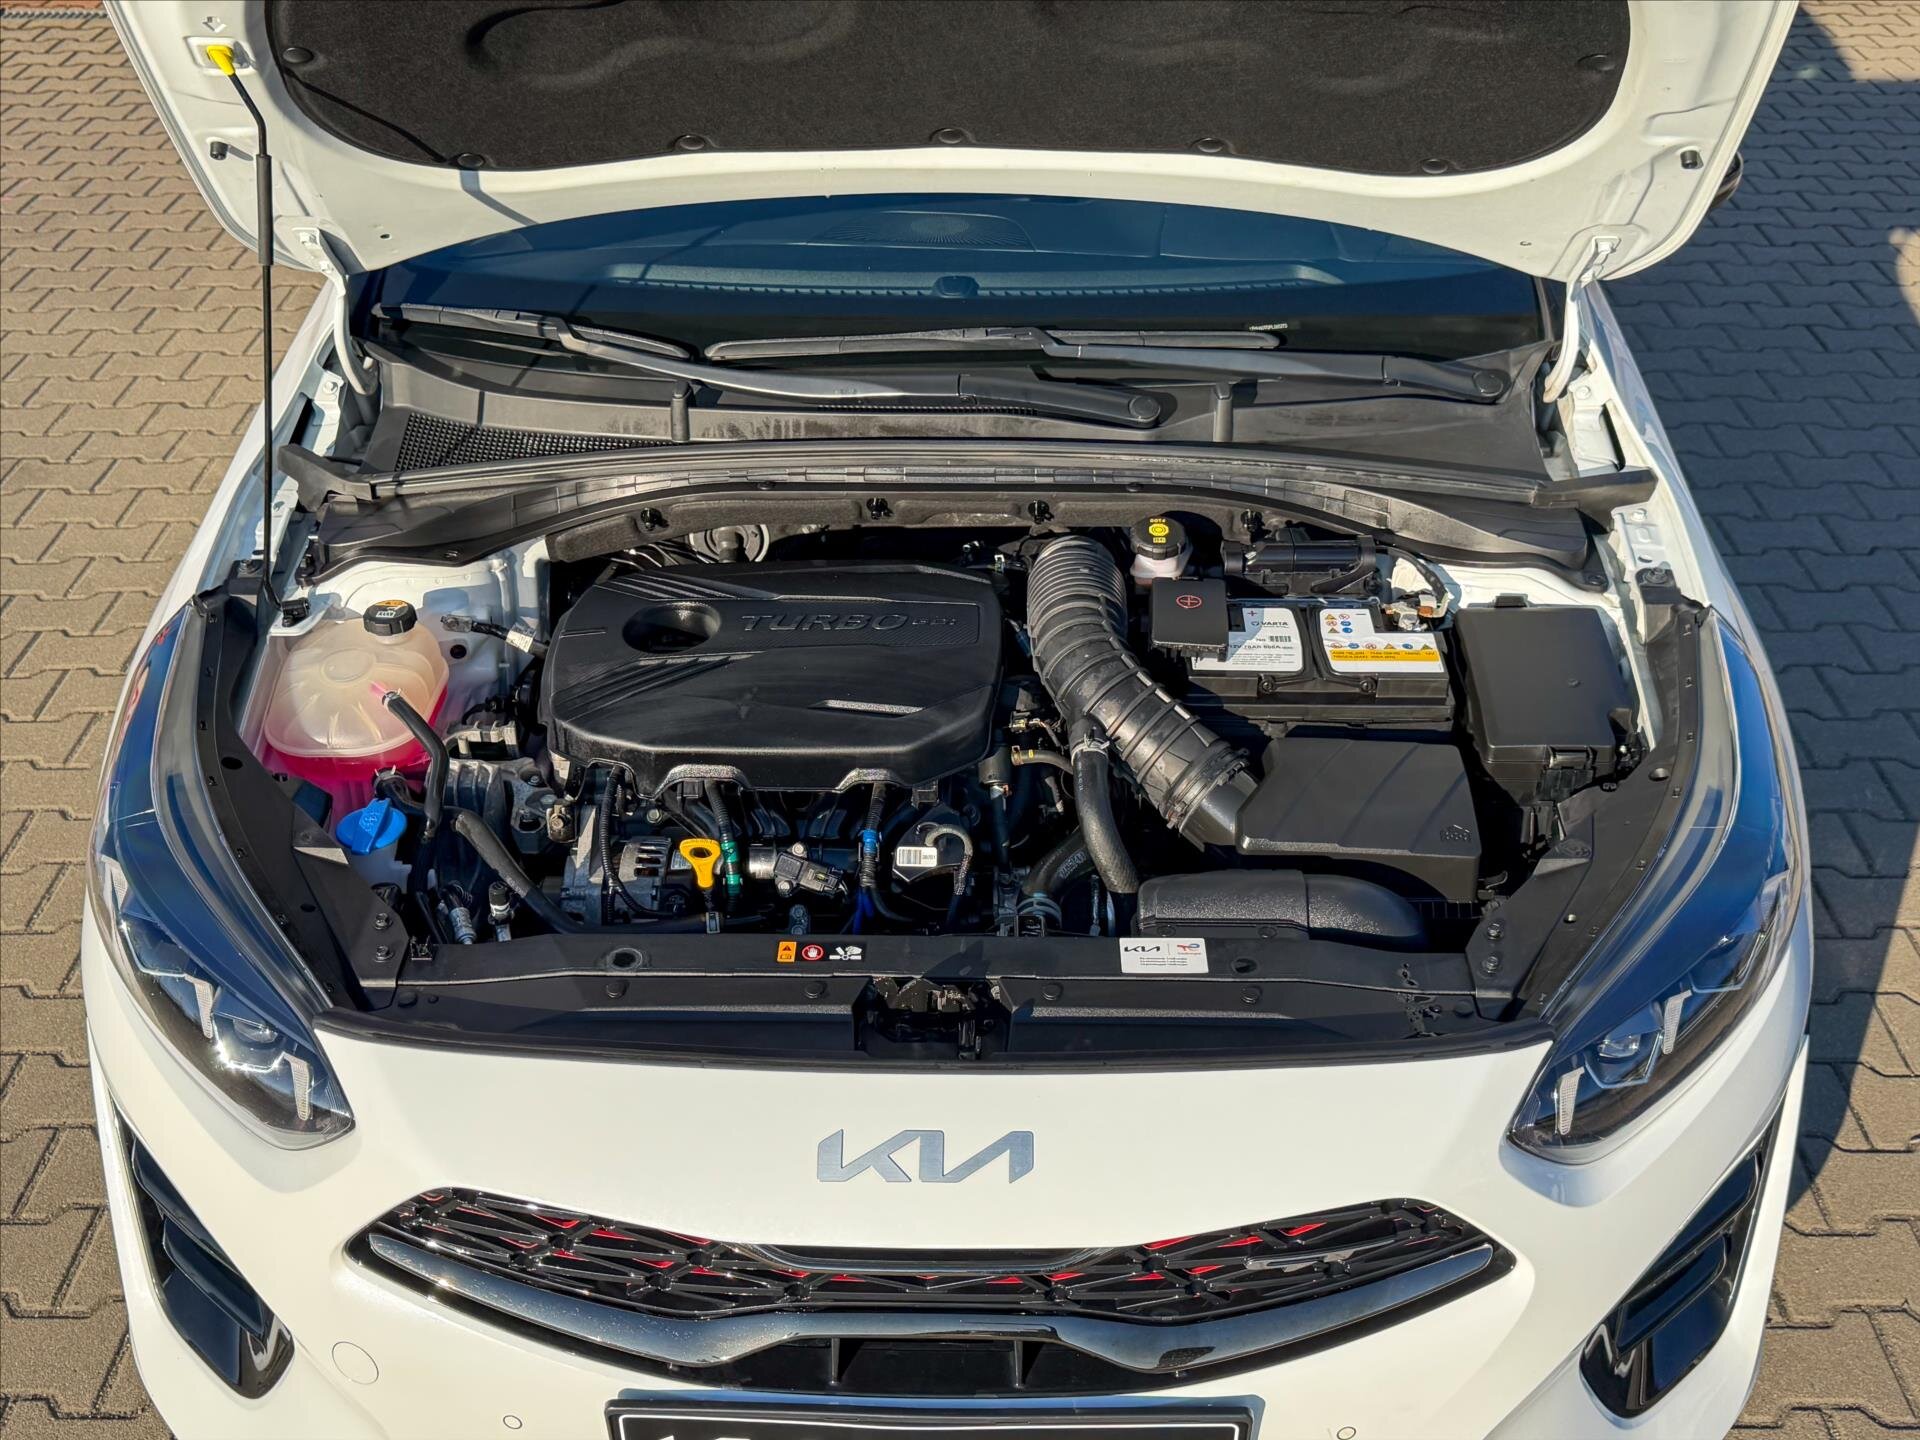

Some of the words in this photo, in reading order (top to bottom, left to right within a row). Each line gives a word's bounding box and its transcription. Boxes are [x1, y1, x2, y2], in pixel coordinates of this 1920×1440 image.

[741, 613, 908, 631] TURBO
[1123, 945, 1161, 953] KIA
[816, 1128, 1034, 1184] KIA
